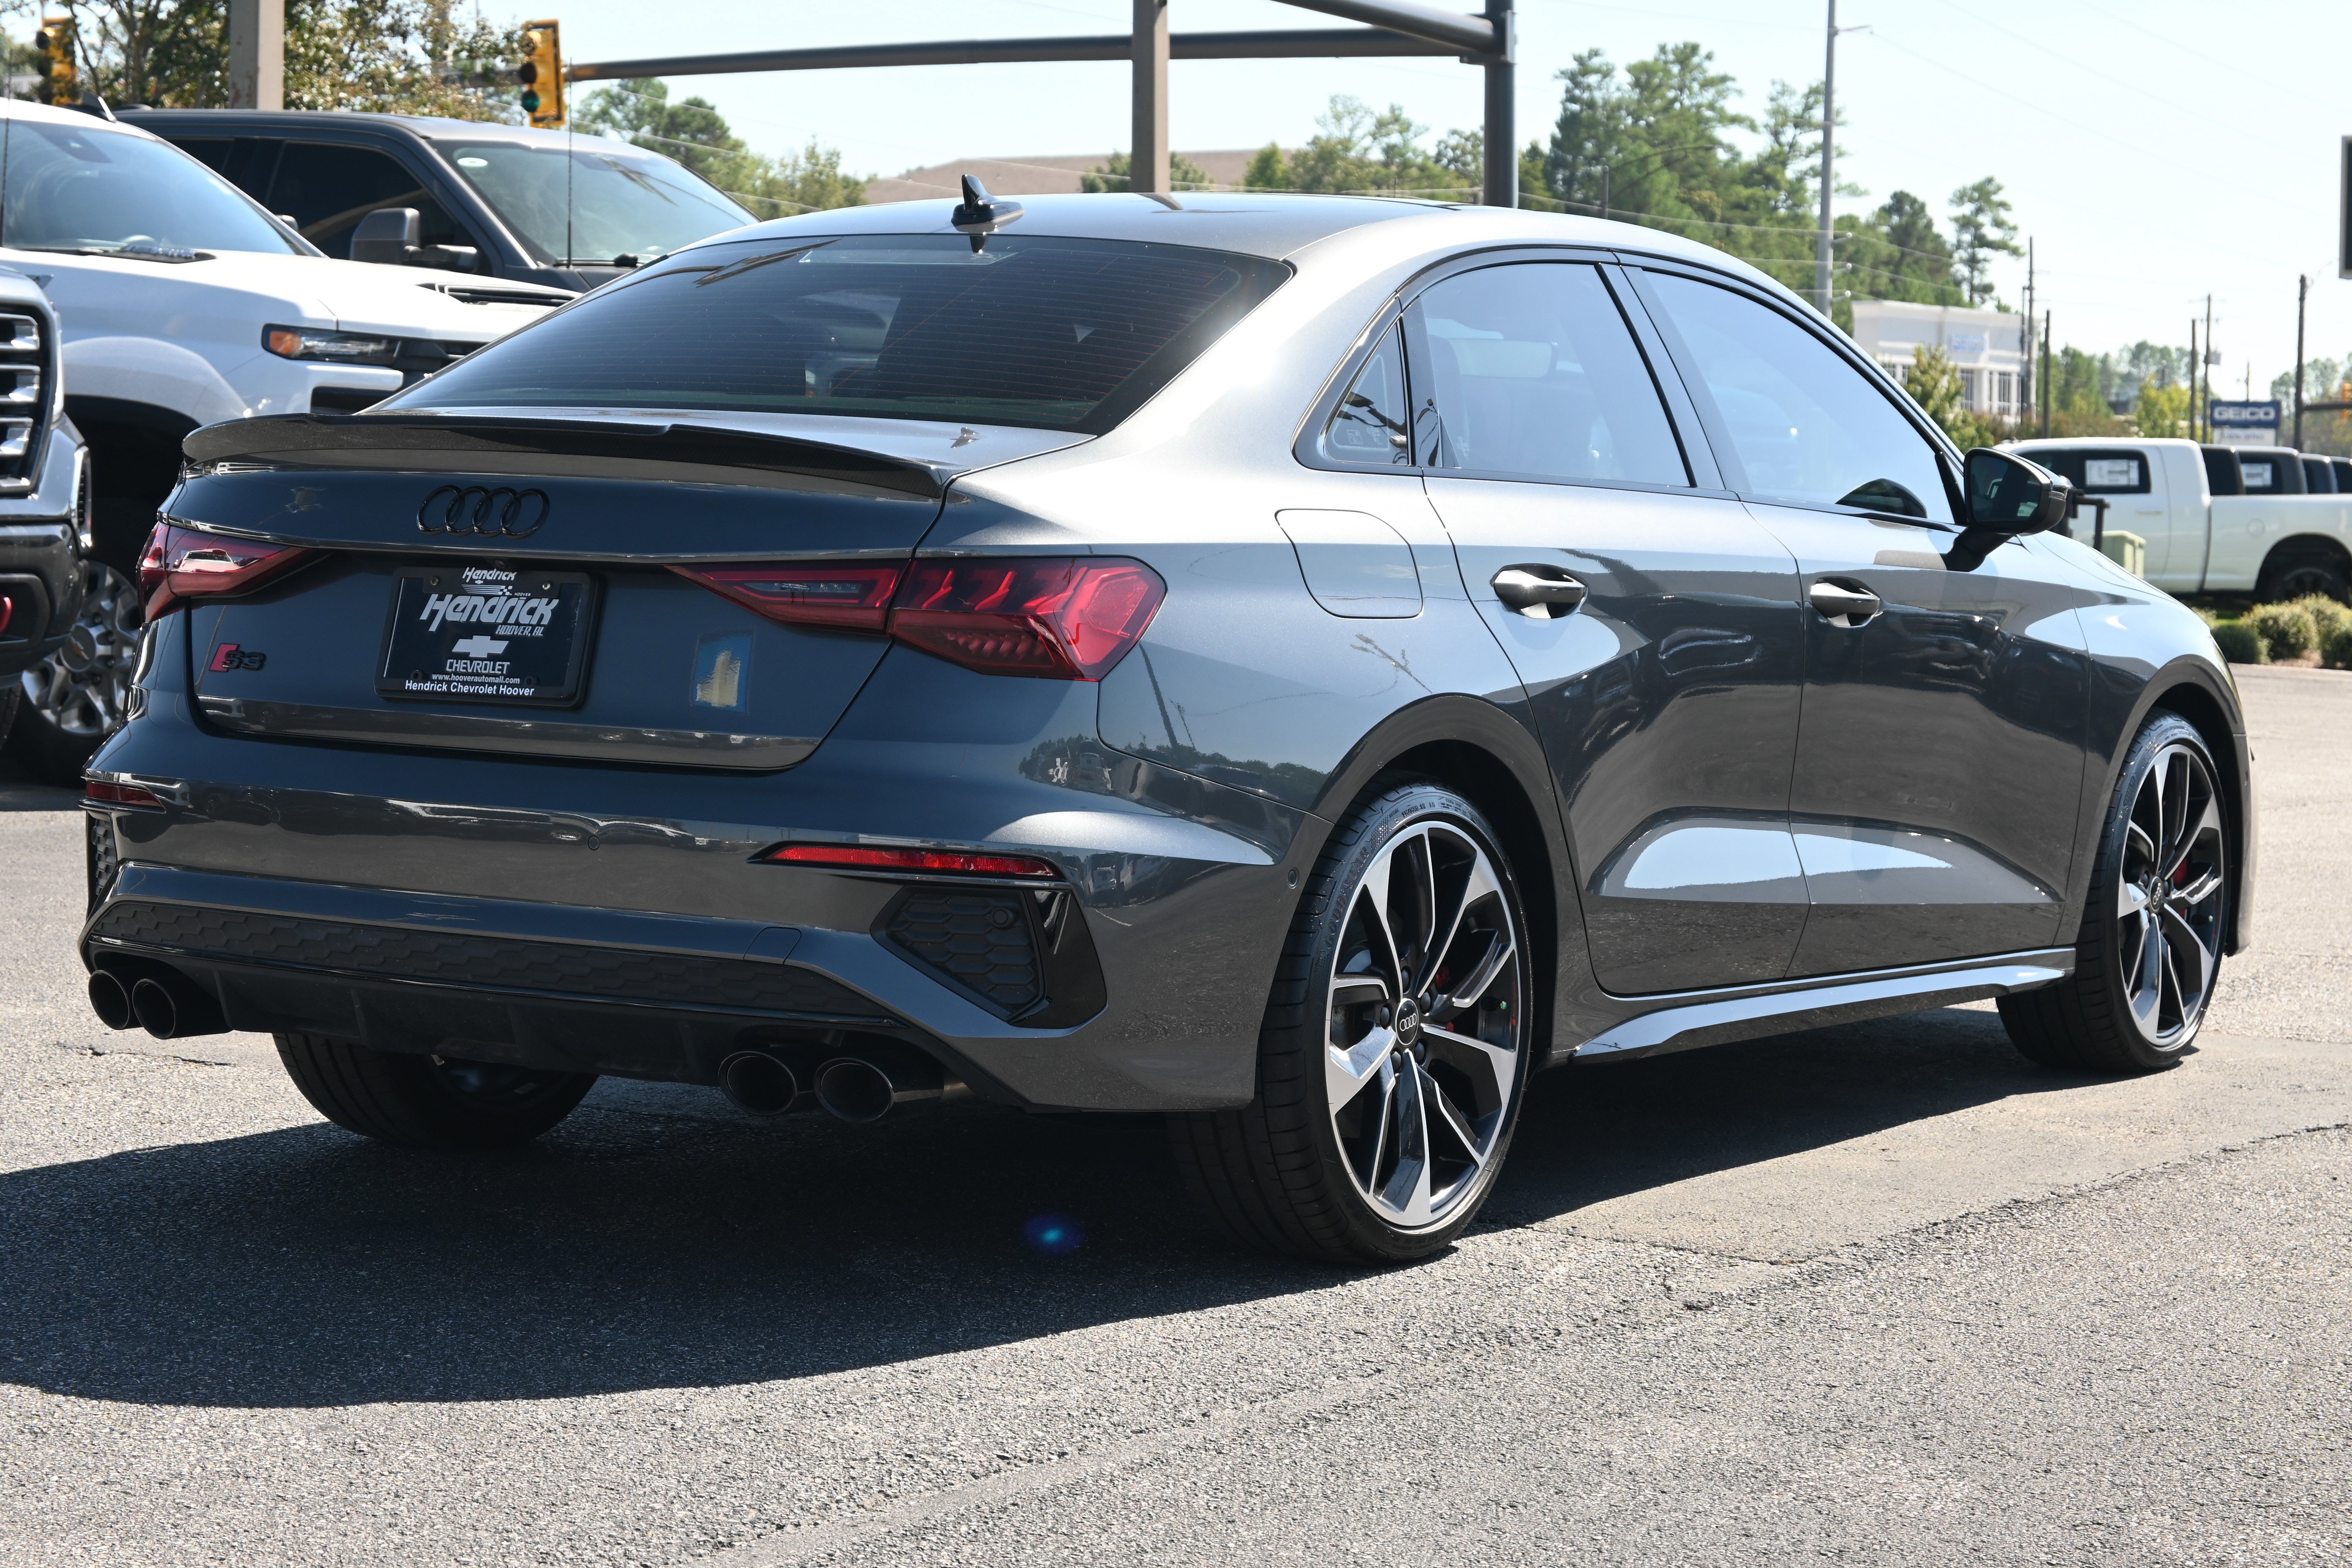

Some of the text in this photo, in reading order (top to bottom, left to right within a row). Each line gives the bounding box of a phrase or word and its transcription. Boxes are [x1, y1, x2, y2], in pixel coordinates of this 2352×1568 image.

[2213, 406, 2276, 421] GEICO
[419, 593, 559, 632] Hendrick
[532, 626, 544, 636] AL
[220, 650, 267, 671] S3
[446, 659, 510, 674] CHEVROLET
[432, 673, 520, 684] www.hooverautomall.com
[405, 680, 535, 696] Hendrick Chevrolet Hoover
[1324, 846, 1370, 950] GOODYEAR
